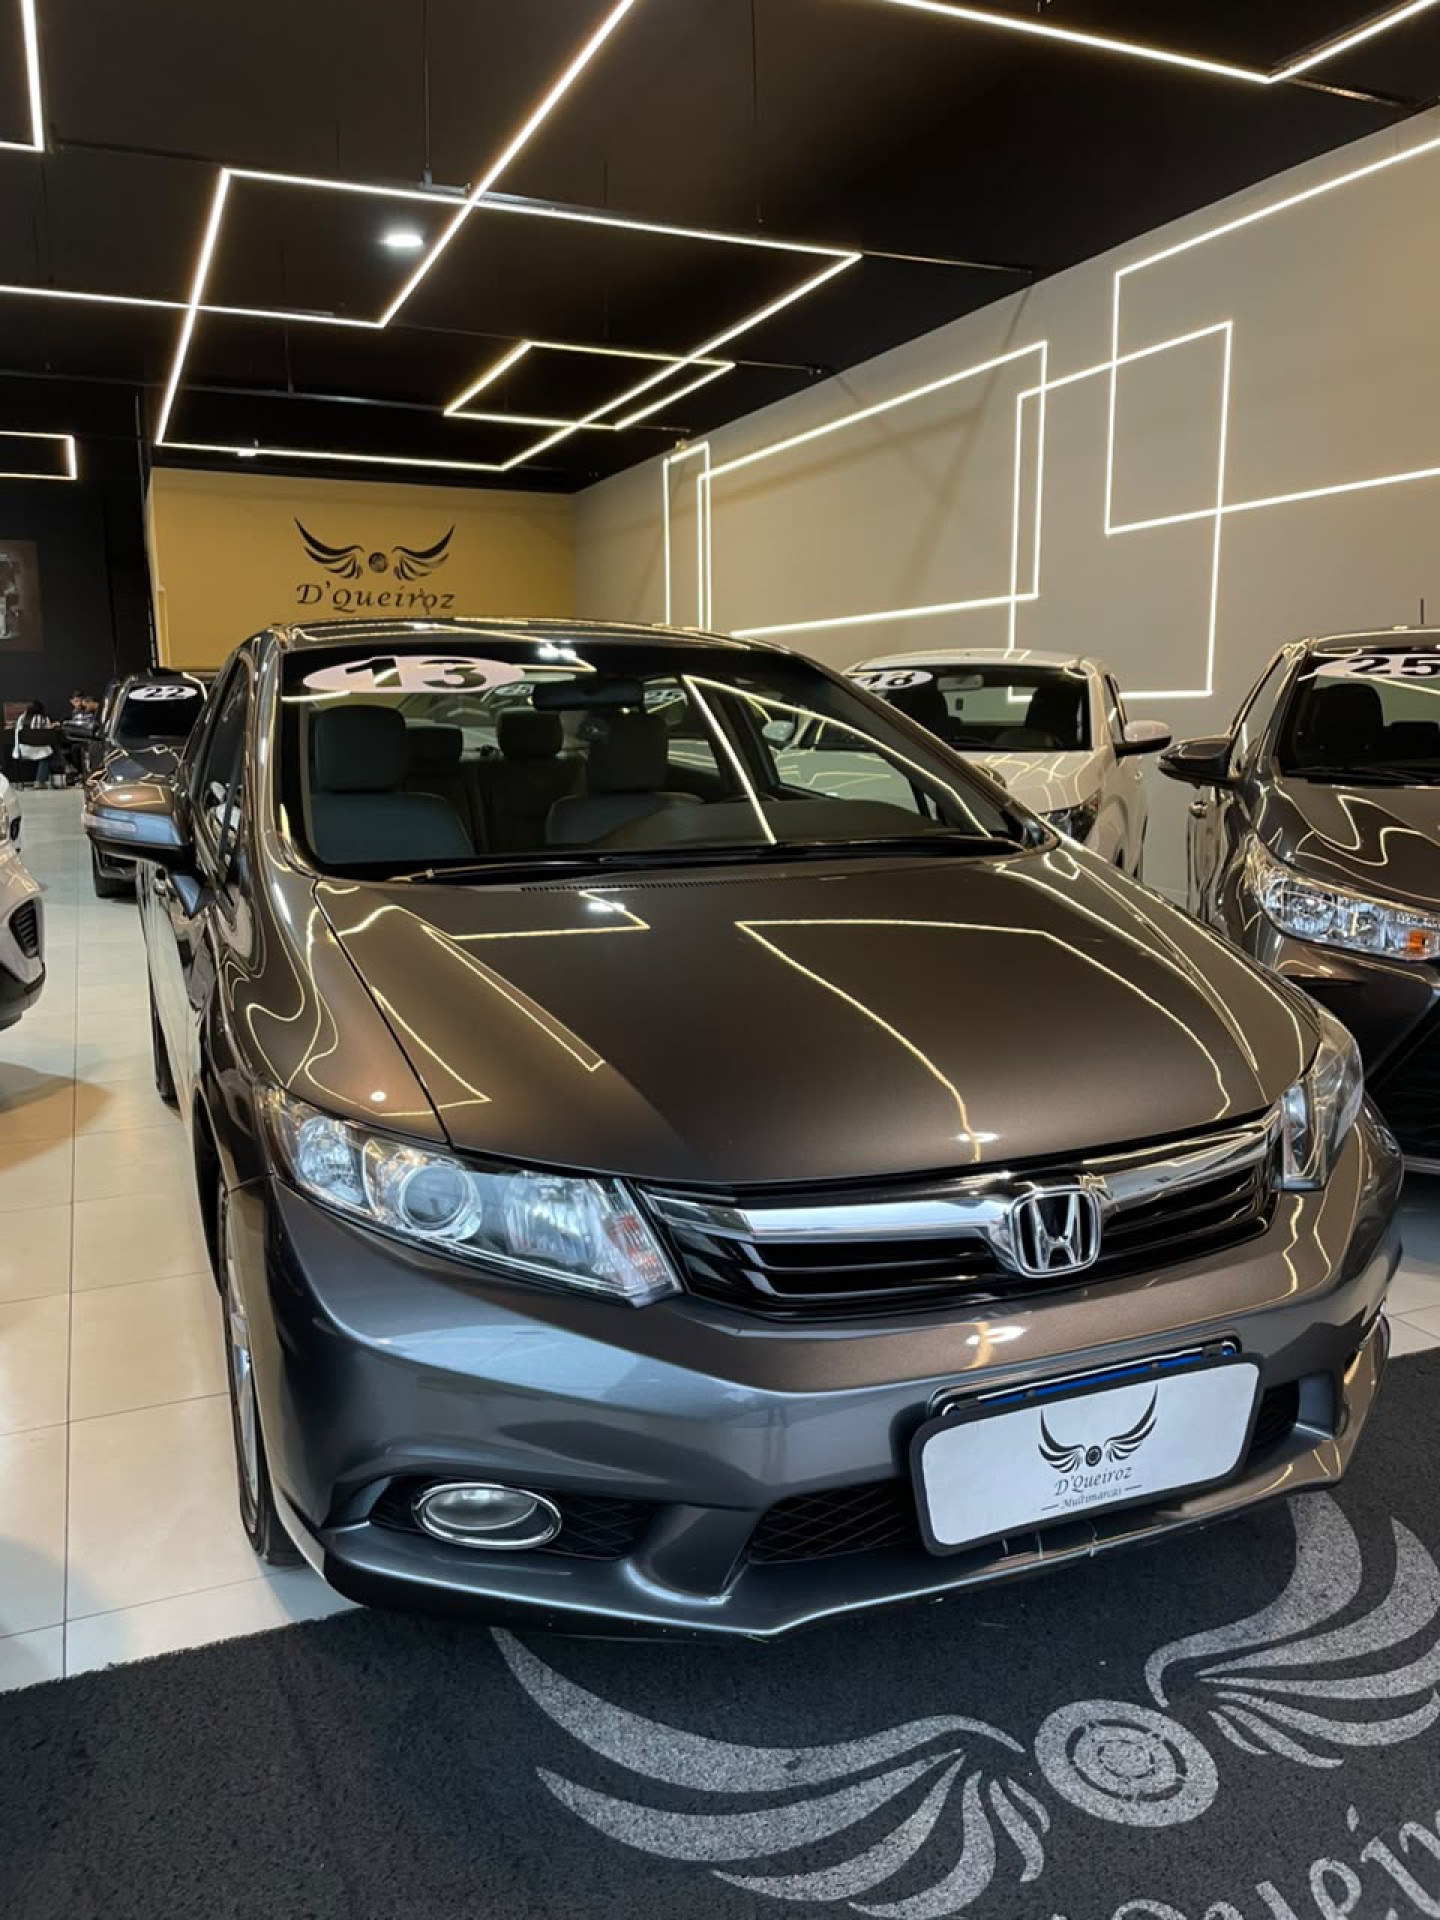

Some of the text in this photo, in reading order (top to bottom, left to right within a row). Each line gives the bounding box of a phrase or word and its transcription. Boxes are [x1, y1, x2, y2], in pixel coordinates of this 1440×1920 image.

[345, 658, 487, 688] 13
[1346, 657, 1440, 676] 25
[144, 687, 185, 698] 22
[1054, 1467, 1132, 1496] D'Queiroz
